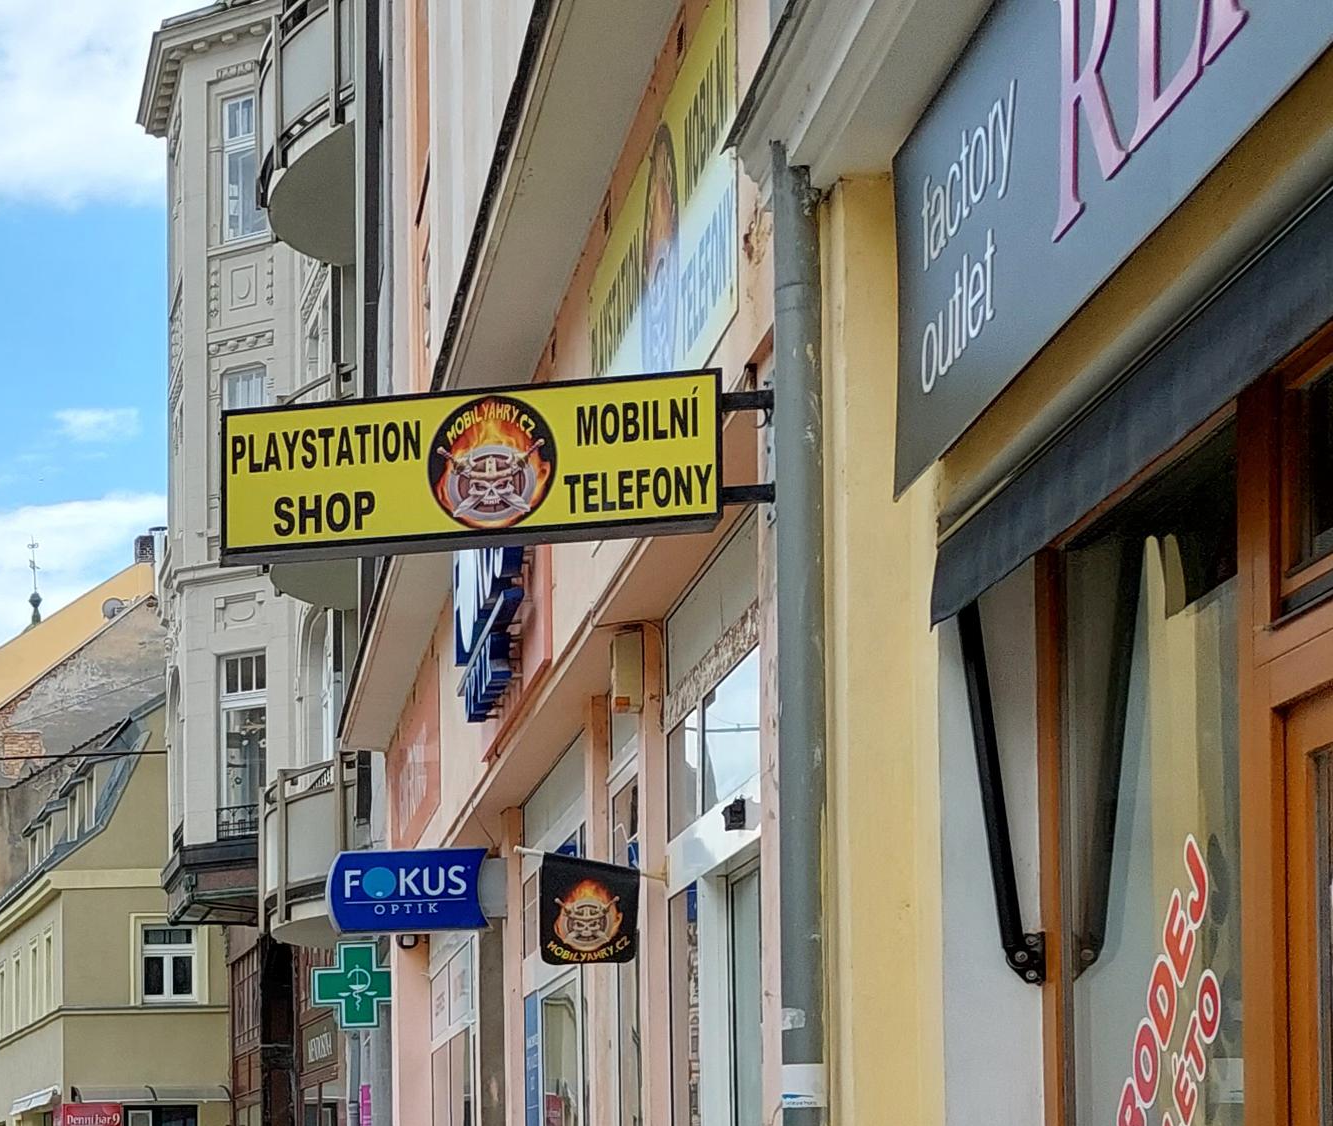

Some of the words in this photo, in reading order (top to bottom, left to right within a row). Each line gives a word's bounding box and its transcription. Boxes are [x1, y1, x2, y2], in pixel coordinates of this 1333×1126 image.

[921, 79, 1018, 272] factory
[920, 229, 997, 394] outlet
[446, 402, 536, 445] MOBILYAHRY.CZ
[576, 386, 700, 447] MOBILNÍ
[231, 420, 422, 474] PLAYSTATION
[564, 464, 713, 515] TELEFONY
[273, 490, 376, 537] SHOP
[344, 864, 467, 899] FOKUS
[373, 903, 439, 916] OPTIK
[547, 935, 631, 962] MOBILYAHRY.CZ
[113, 1113, 121, 1126] 9
